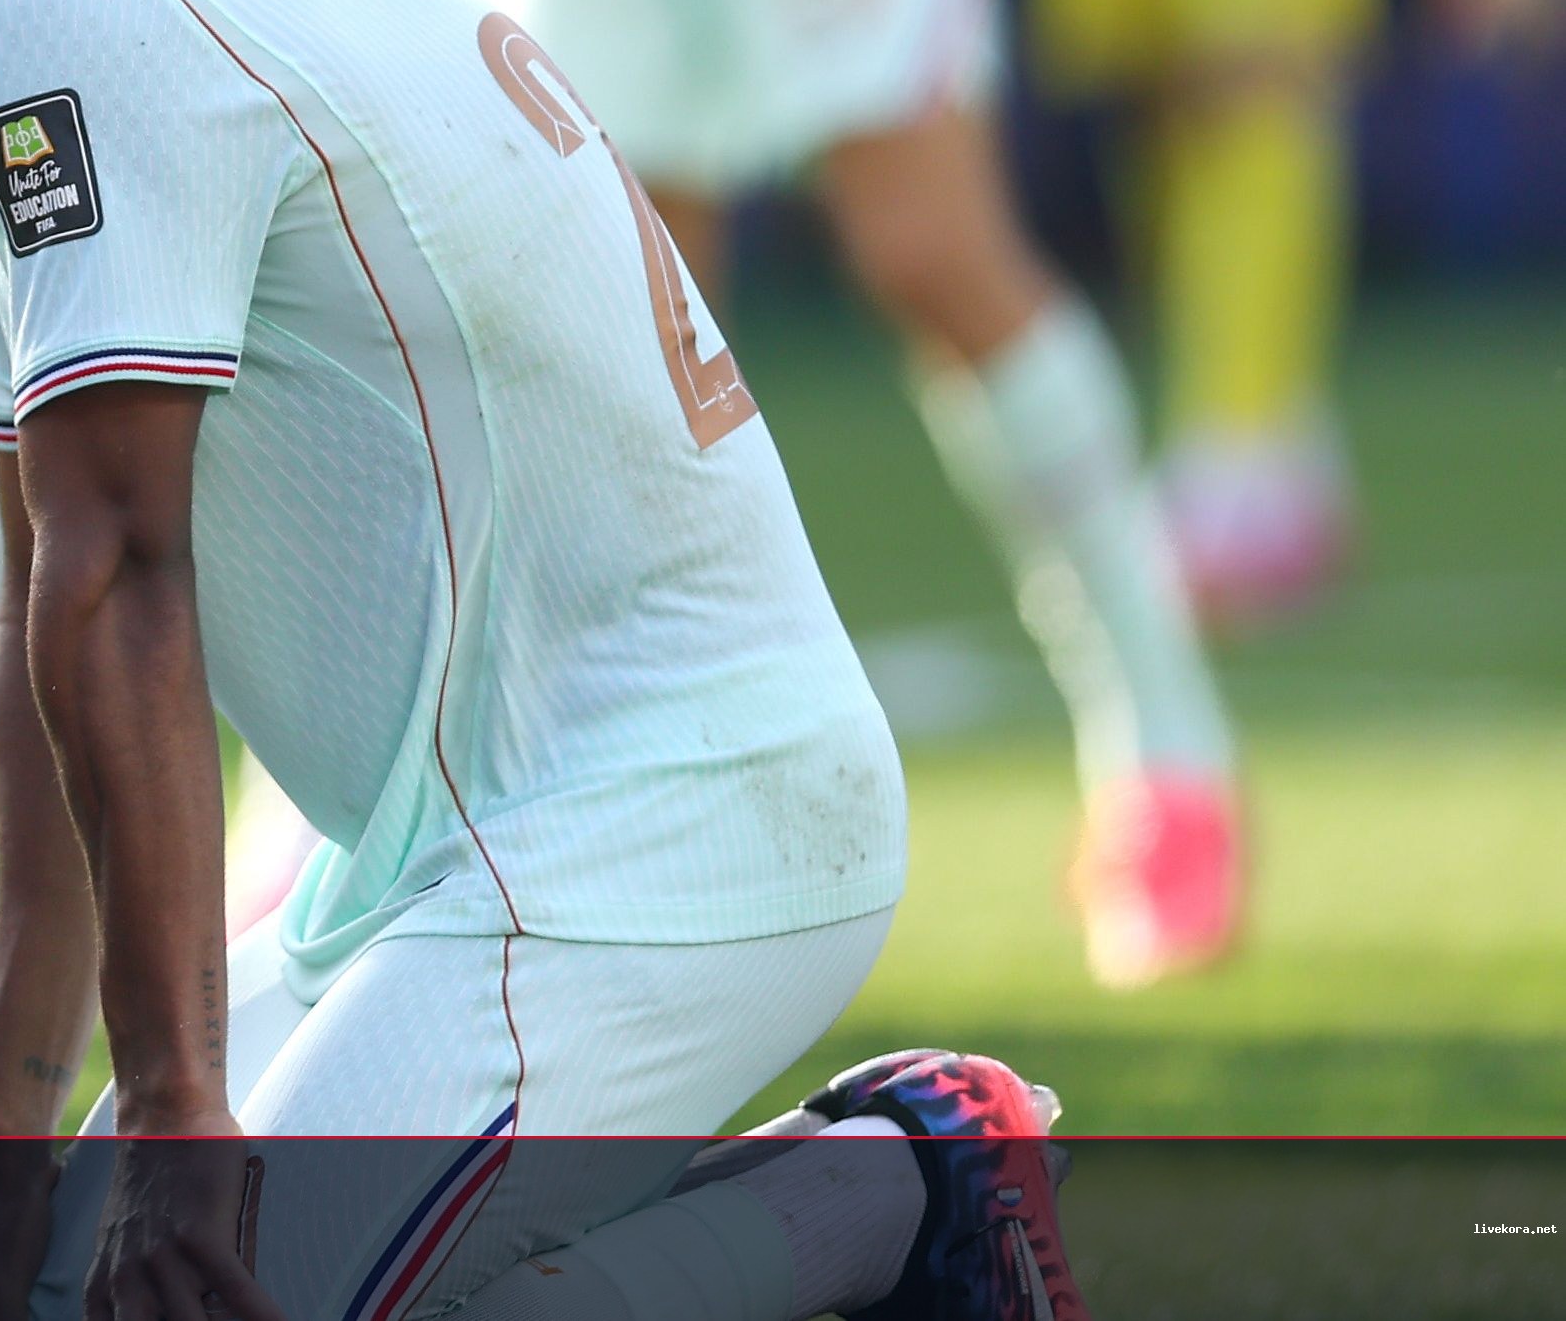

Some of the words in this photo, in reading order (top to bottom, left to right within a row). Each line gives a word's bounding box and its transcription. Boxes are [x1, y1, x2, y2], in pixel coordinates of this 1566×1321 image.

[8, 168, 43, 197] Unite
[40, 159, 62, 186] For
[10, 183, 80, 224] EDUCATION
[35, 216, 56, 233] FIFA
